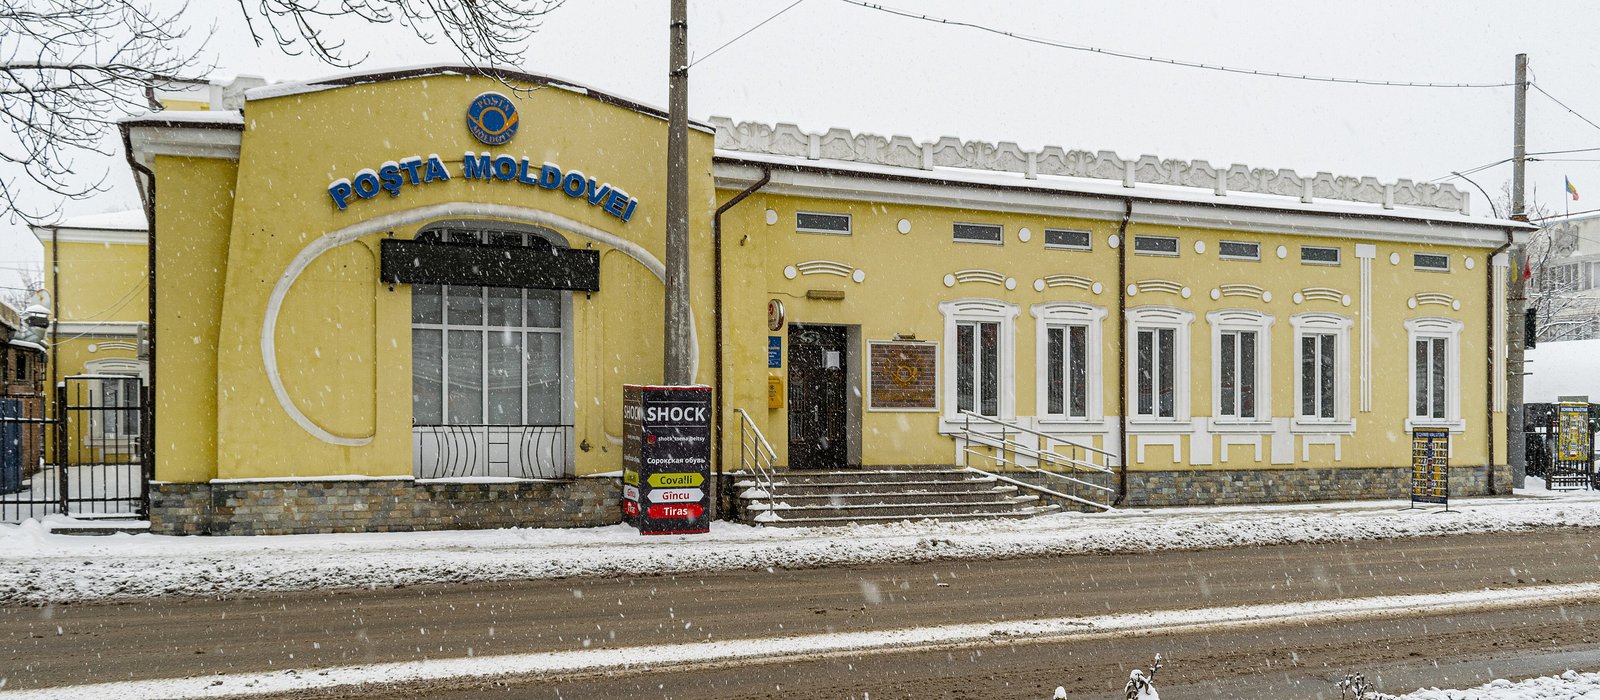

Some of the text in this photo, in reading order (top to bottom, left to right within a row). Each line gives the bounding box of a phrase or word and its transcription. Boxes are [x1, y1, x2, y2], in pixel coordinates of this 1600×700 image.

[464, 153, 638, 223] MOLDOVEI
[647, 407, 706, 422] SHOCK
[647, 457, 684, 466] Сорокская
[685, 456, 706, 465] обувь
[660, 475, 693, 485] Covalli
[662, 491, 690, 500] Gîncu
[664, 506, 688, 516] Tiras
